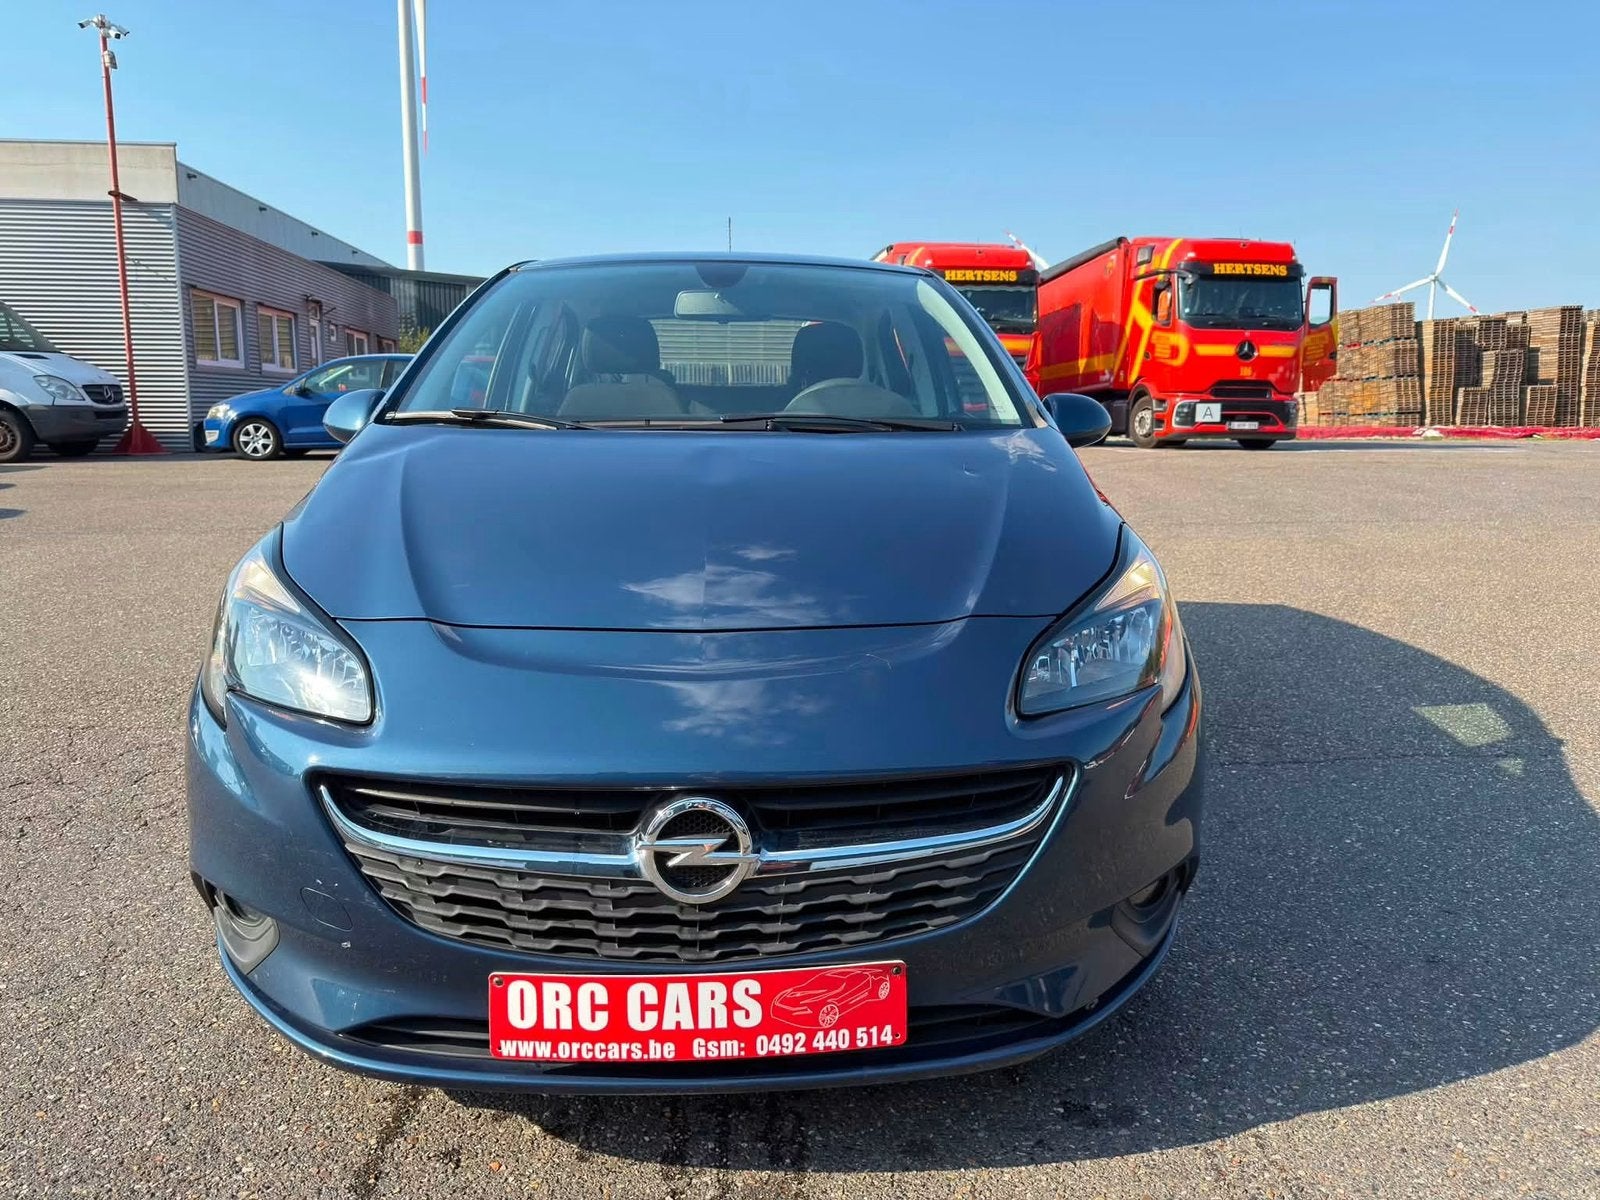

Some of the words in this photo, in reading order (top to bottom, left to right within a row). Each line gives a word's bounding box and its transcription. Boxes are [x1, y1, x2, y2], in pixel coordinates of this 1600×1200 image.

[944, 269, 1018, 281] HERTSENS
[1213, 263, 1288, 276] HERTSENS
[1202, 405, 1214, 420] A
[507, 980, 609, 1031] ORC
[626, 979, 763, 1031] CARS
[500, 1038, 676, 1060] www.orccars.be
[692, 1037, 745, 1058] Gsm:
[756, 1032, 806, 1056] 0492
[812, 1028, 850, 1051] 440
[856, 1024, 893, 1048] 514
